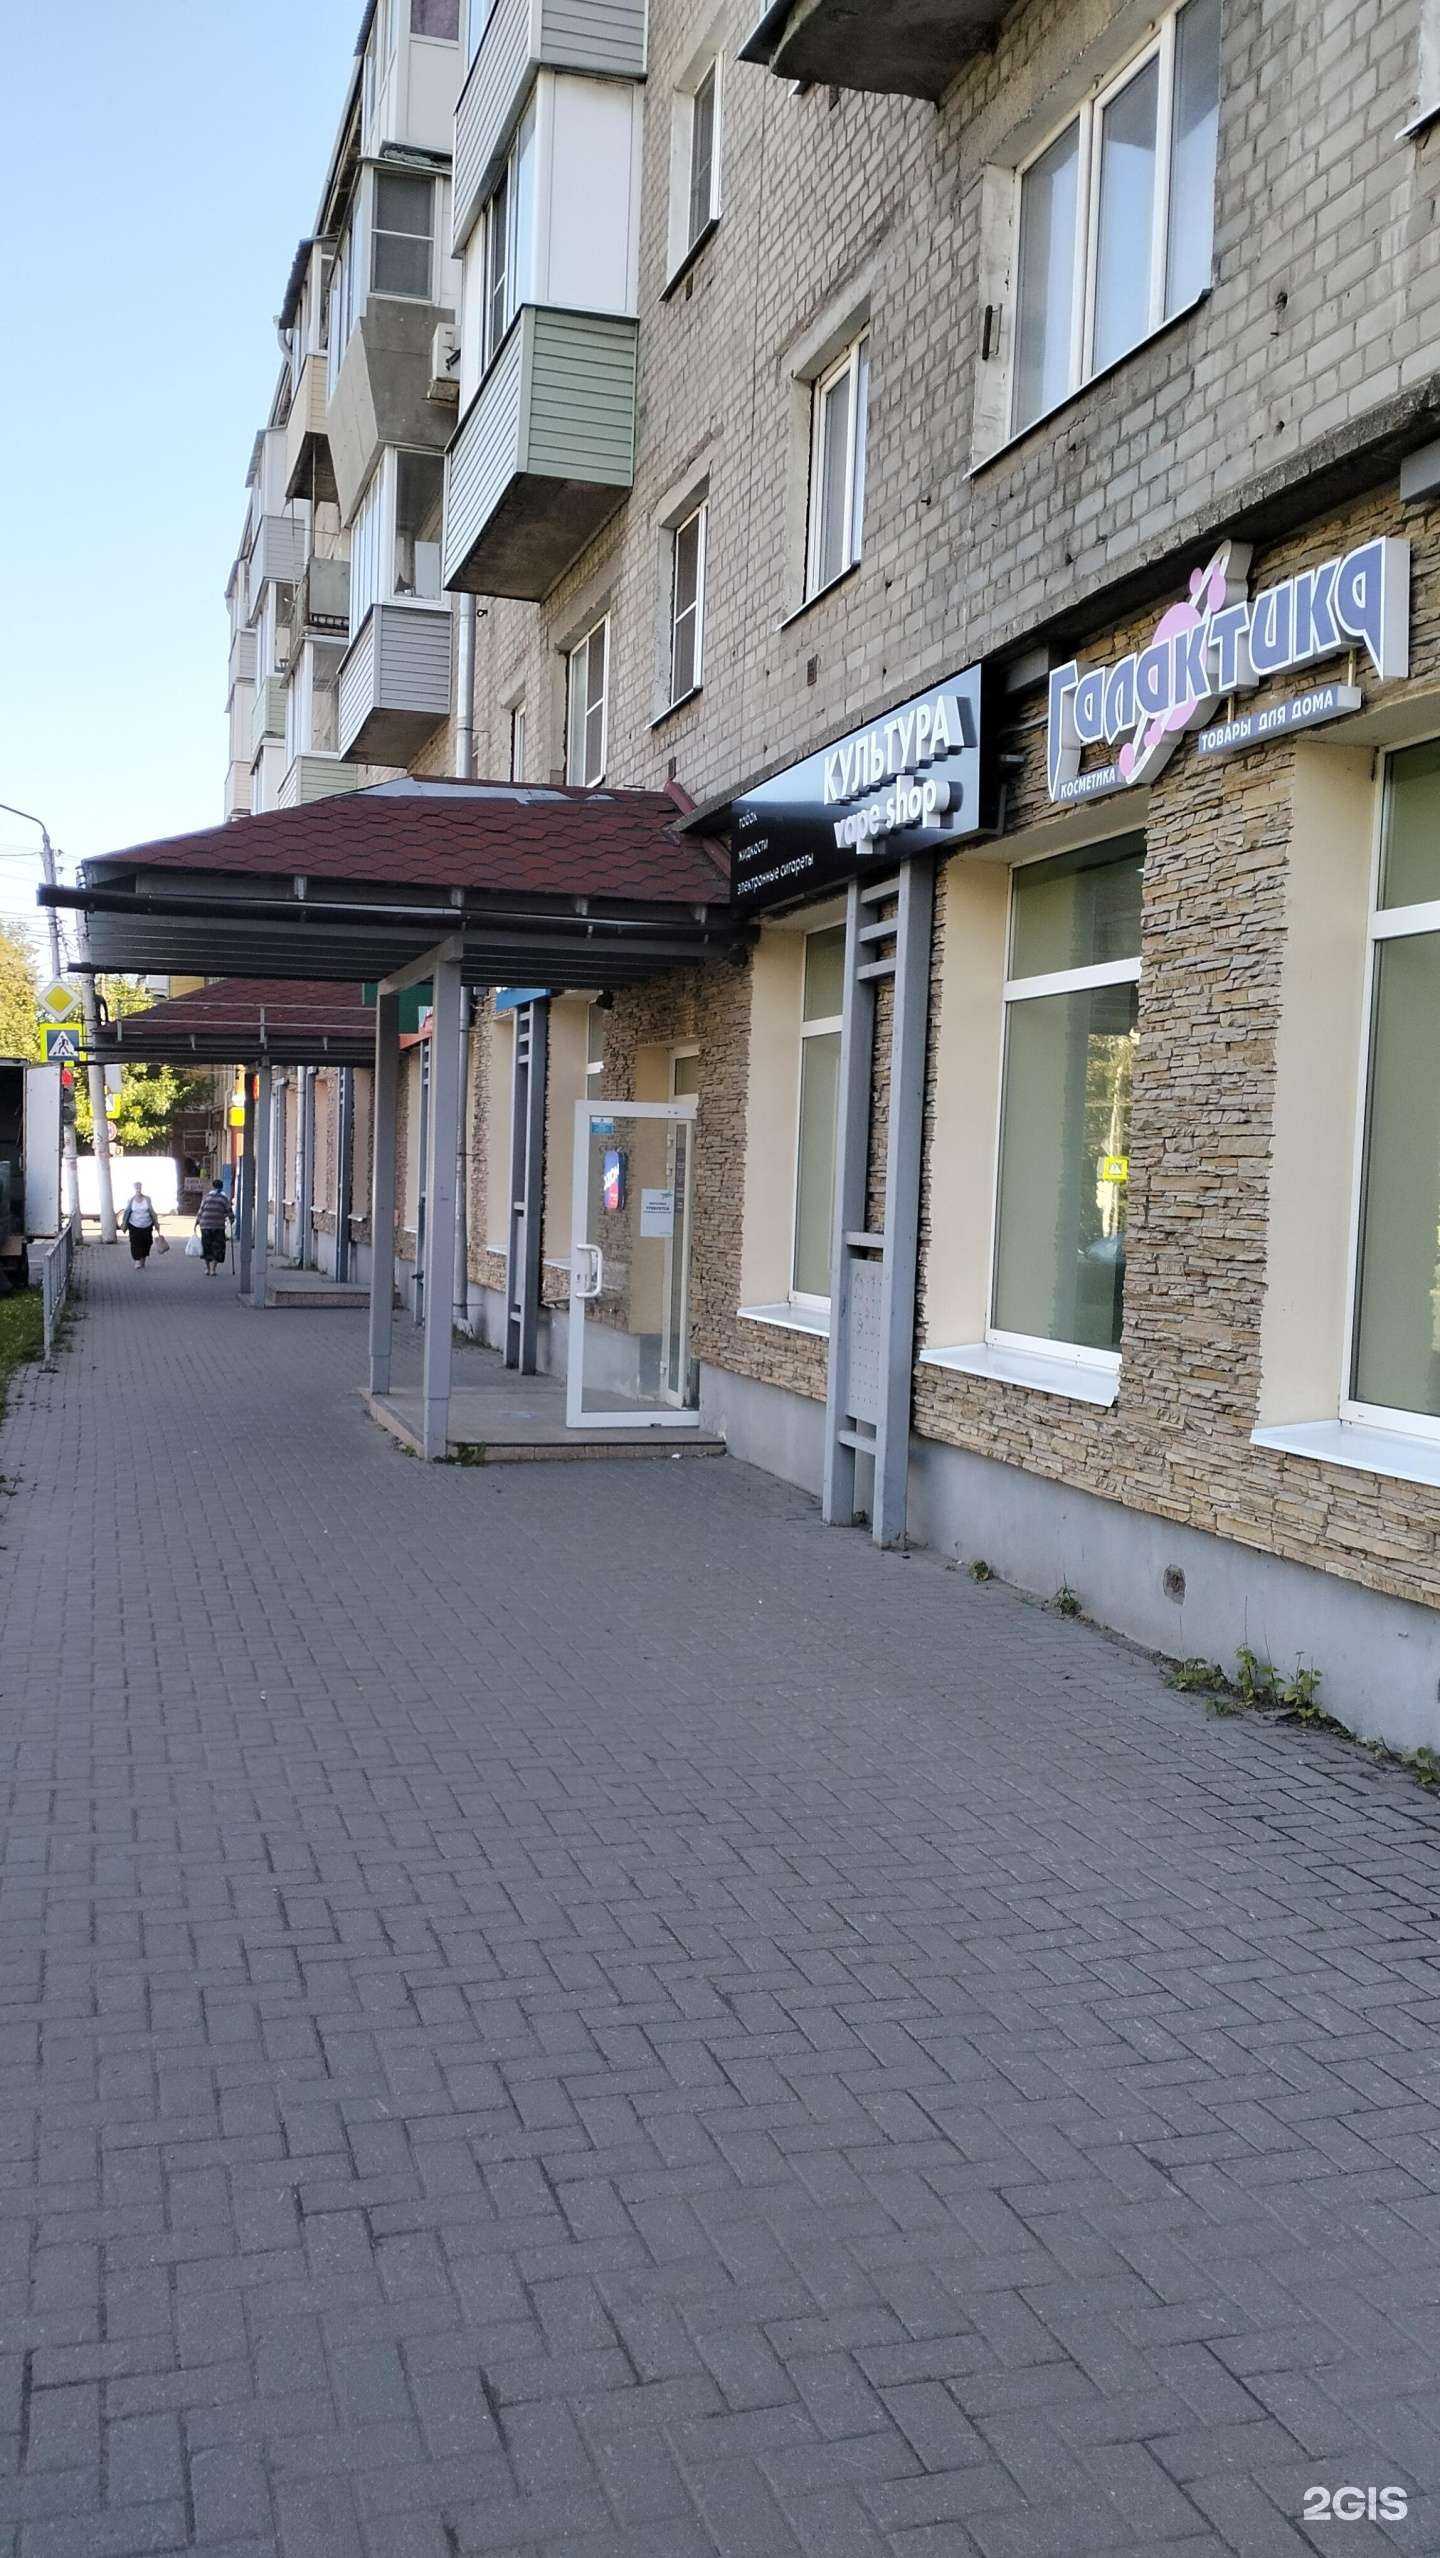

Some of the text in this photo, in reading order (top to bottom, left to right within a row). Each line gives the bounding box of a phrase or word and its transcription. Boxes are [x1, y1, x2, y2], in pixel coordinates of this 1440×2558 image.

[824, 695, 964, 805] КУЛЬТУРА
[1201, 689, 1333, 751] ТОВАРЫ ДЛЯ ДОМА
[1060, 767, 1116, 799] КОСМЕТИКА
[834, 775, 951, 854] vape shop
[780, 852, 814, 877] сигареты
